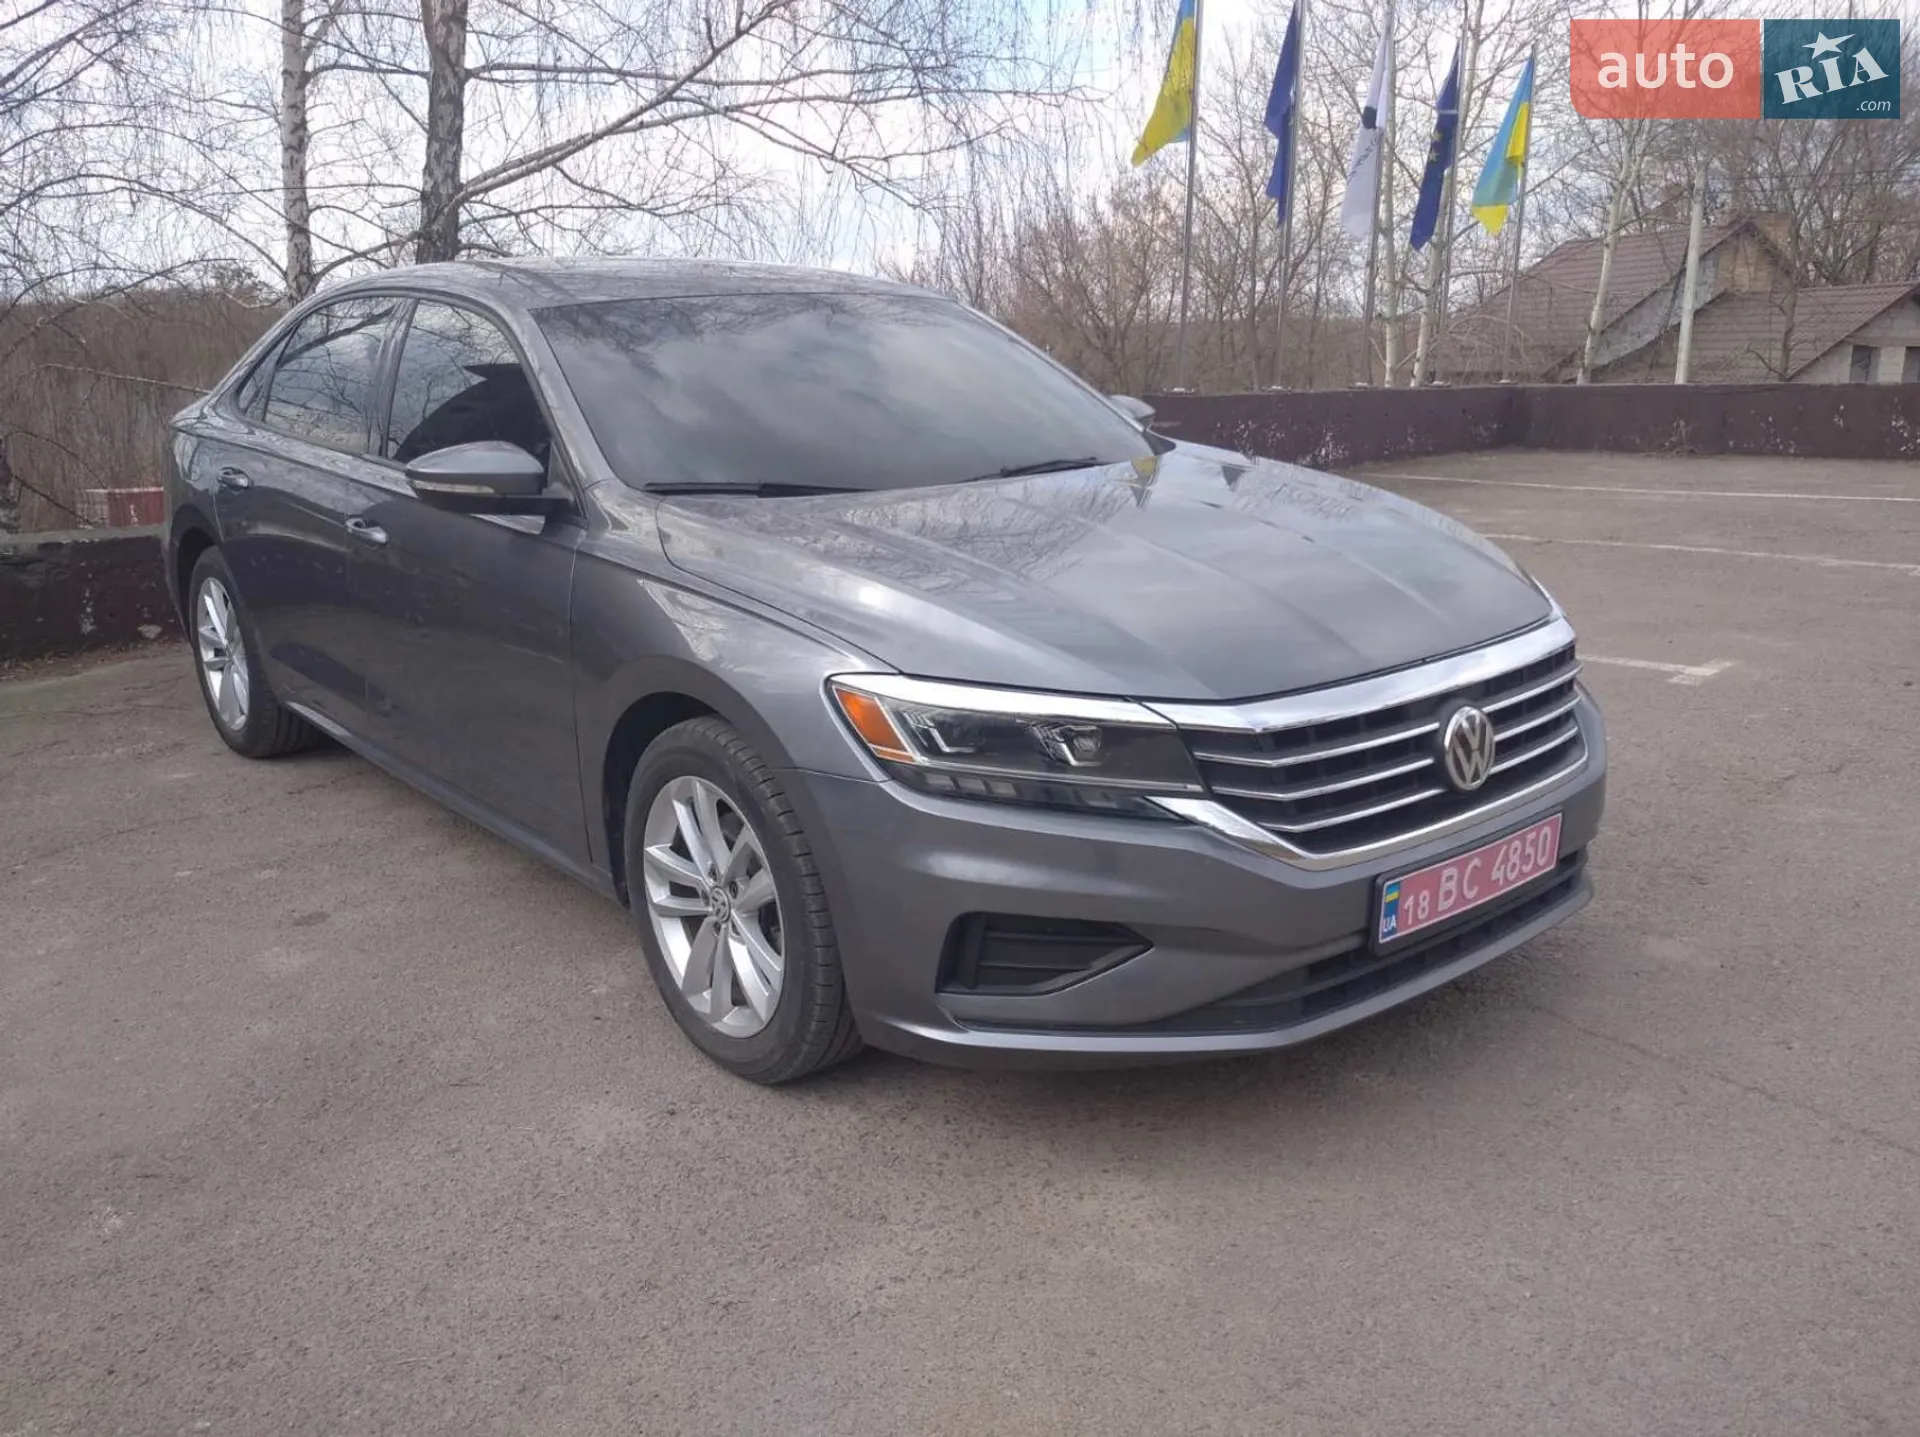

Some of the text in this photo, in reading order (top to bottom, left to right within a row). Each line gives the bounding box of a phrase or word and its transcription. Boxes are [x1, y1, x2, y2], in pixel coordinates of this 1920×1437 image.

[1404, 826, 1552, 925] 18 BC 4850
[1383, 915, 1398, 933] UA
